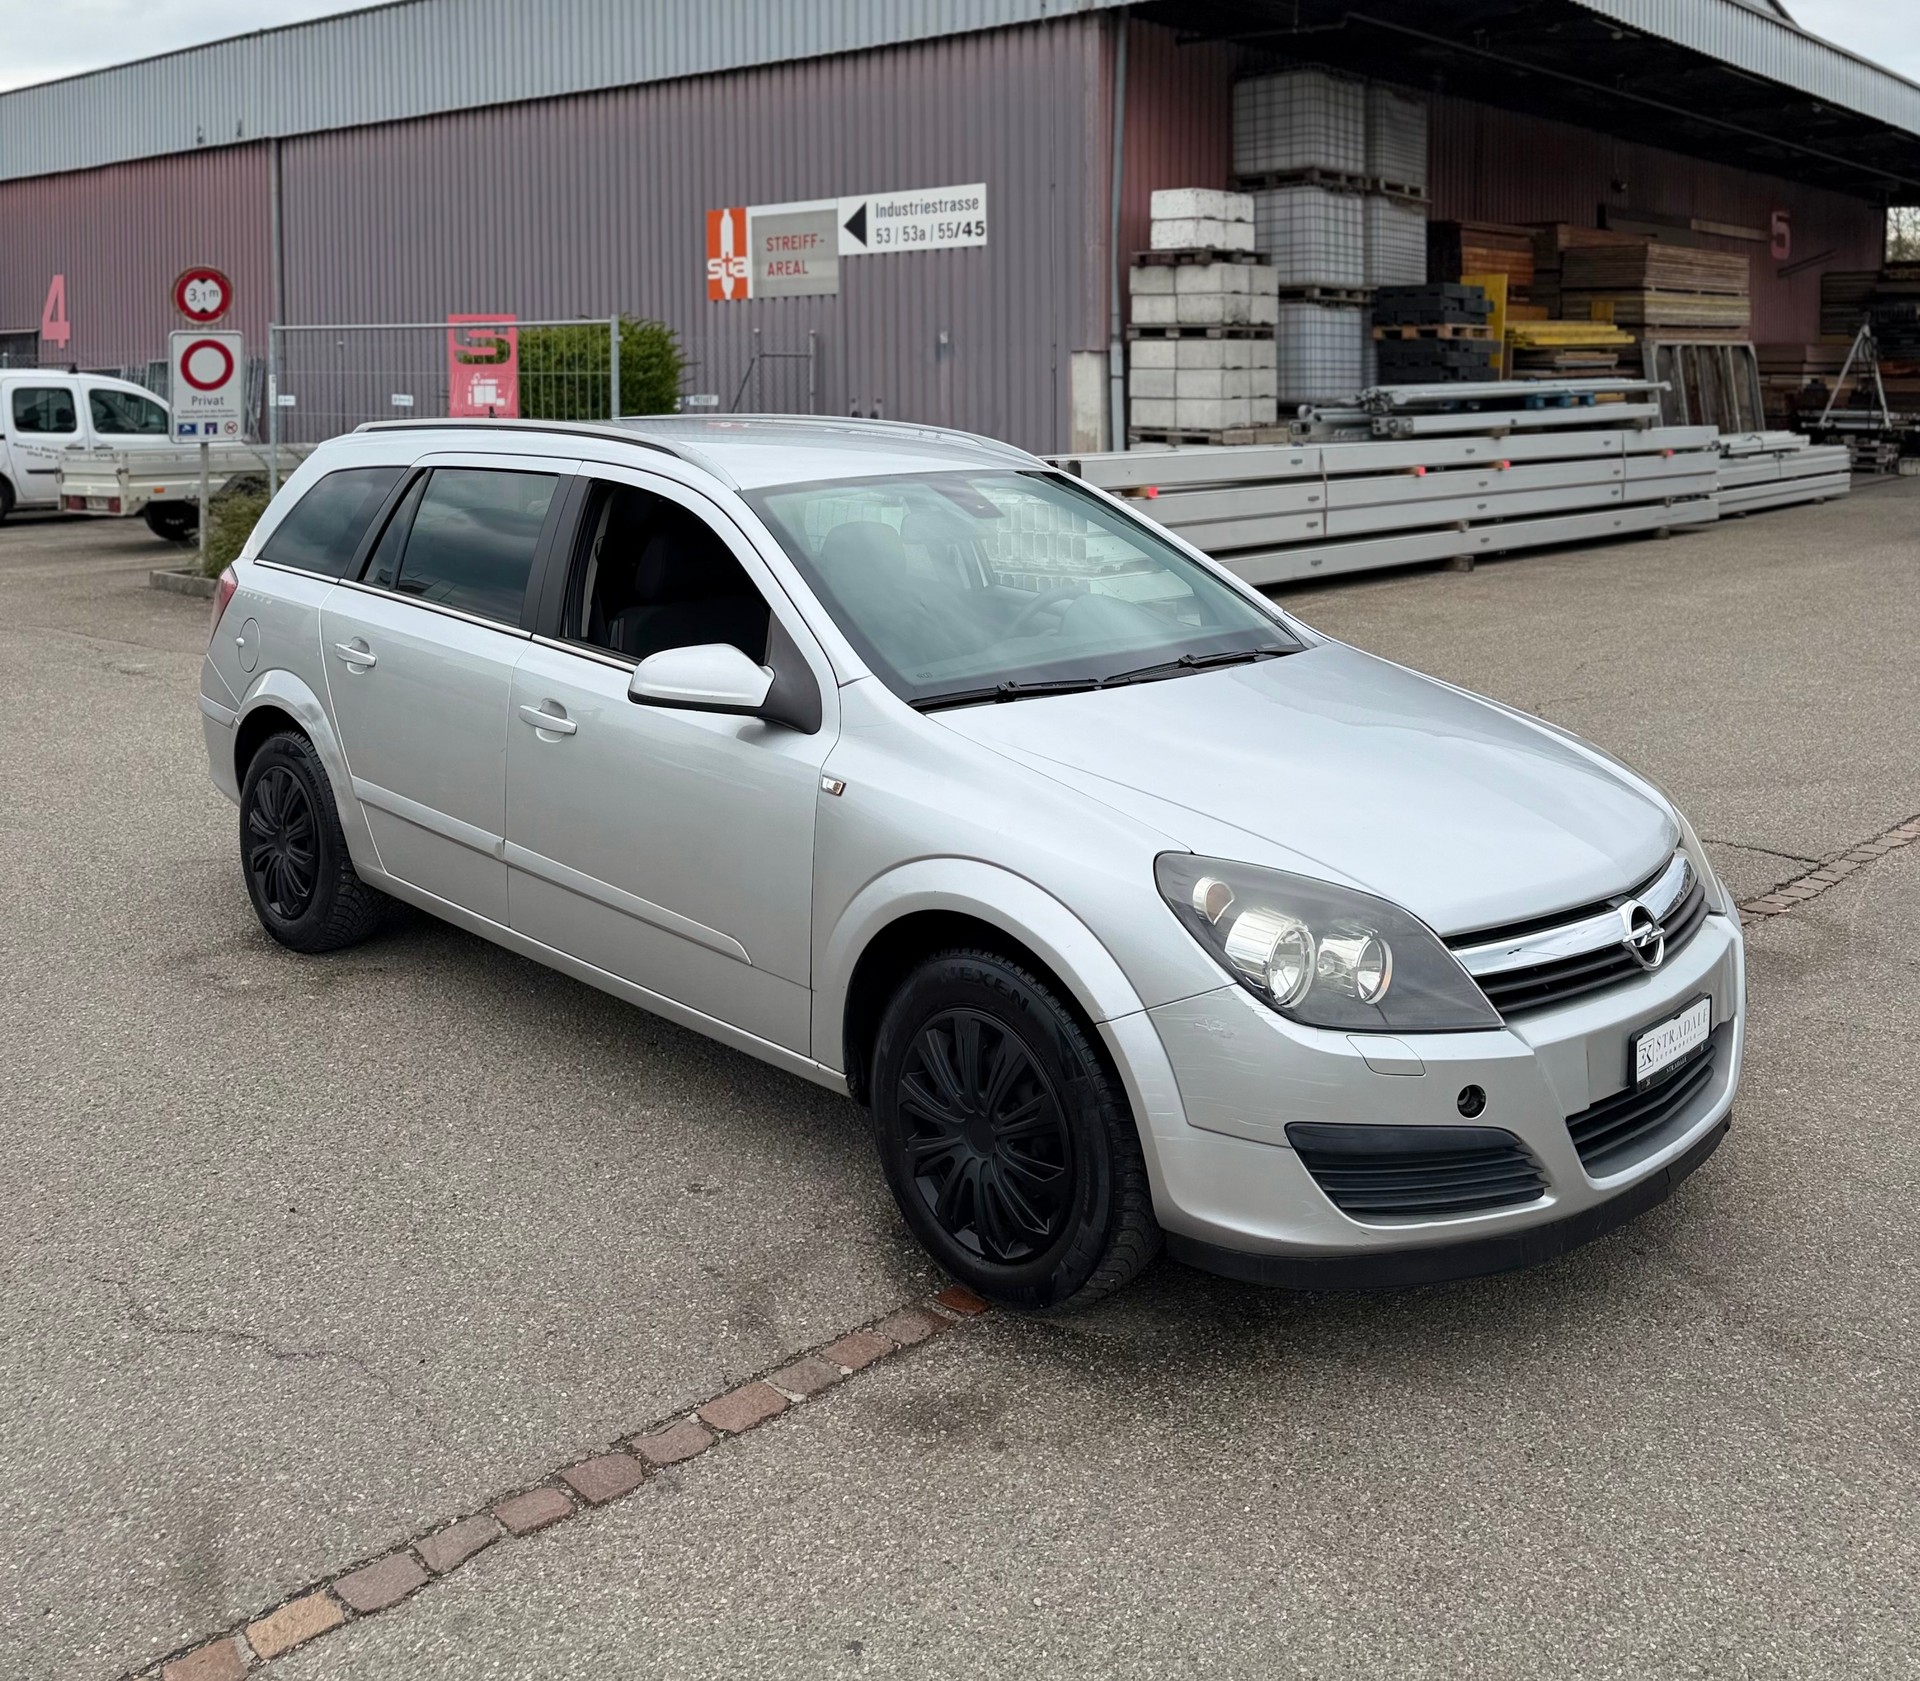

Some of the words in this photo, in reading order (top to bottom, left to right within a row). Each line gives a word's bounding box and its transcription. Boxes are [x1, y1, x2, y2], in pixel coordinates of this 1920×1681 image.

[875, 198, 979, 218] Industriestrasse
[766, 233, 825, 252] STREIFF-
[876, 227, 891, 244] 53
[902, 225, 926, 242] 53a
[1771, 211, 1791, 260] 5
[767, 260, 809, 277] AREAL
[42, 274, 71, 349] 4
[191, 396, 224, 406] Privat
[941, 965, 1030, 1012] NEXEN
[1656, 1007, 1708, 1052] STRADALE
